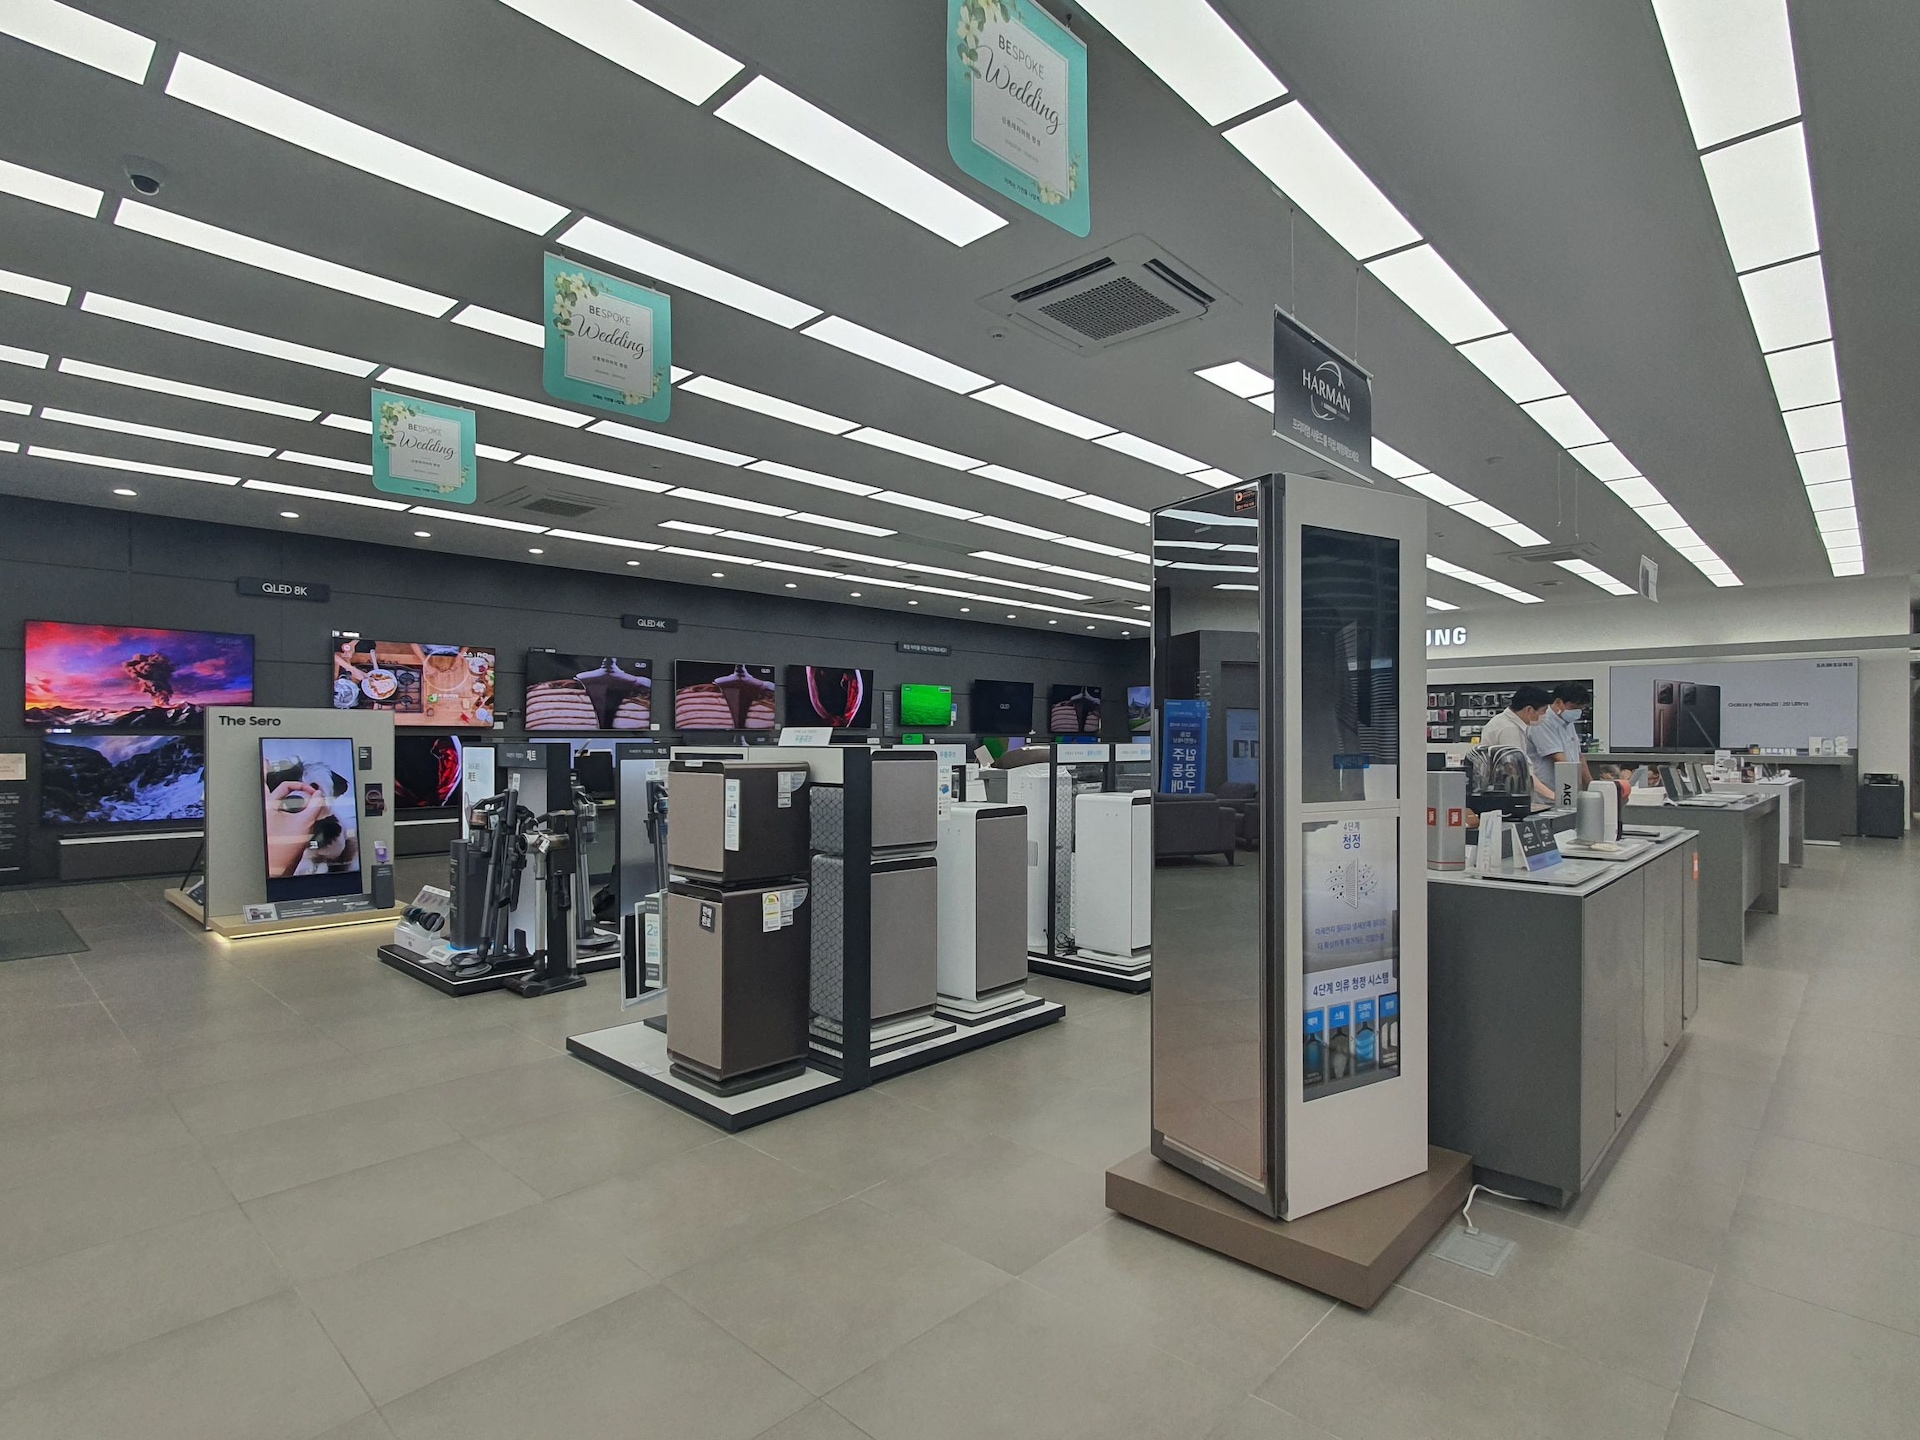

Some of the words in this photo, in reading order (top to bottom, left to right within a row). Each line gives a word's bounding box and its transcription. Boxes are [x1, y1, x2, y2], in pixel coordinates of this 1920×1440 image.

[999, 34, 1045, 80] BESPOKE
[976, 45, 1064, 135] Wedding
[588, 305, 631, 327] BESPOKE
[570, 314, 647, 360] Wedding
[1302, 369, 1351, 413] HARMAN
[408, 423, 443, 436] BESPOKE
[393, 430, 456, 460] Wedding
[262, 582, 292, 595] QLED
[294, 586, 308, 596] 8K
[637, 618, 656, 628] QLED
[655, 620, 666, 629] 4K
[219, 715, 246, 726] The
[249, 716, 281, 727] Sero
[1563, 783, 1572, 806] AKG
[1343, 821, 1361, 832] 4단계
[1343, 833, 1361, 850] 청정
[1313, 982, 1333, 997] 4단계
[1335, 979, 1350, 992] 의류
[1351, 975, 1366, 990] 청정
[1368, 971, 1390, 988] 시스템
